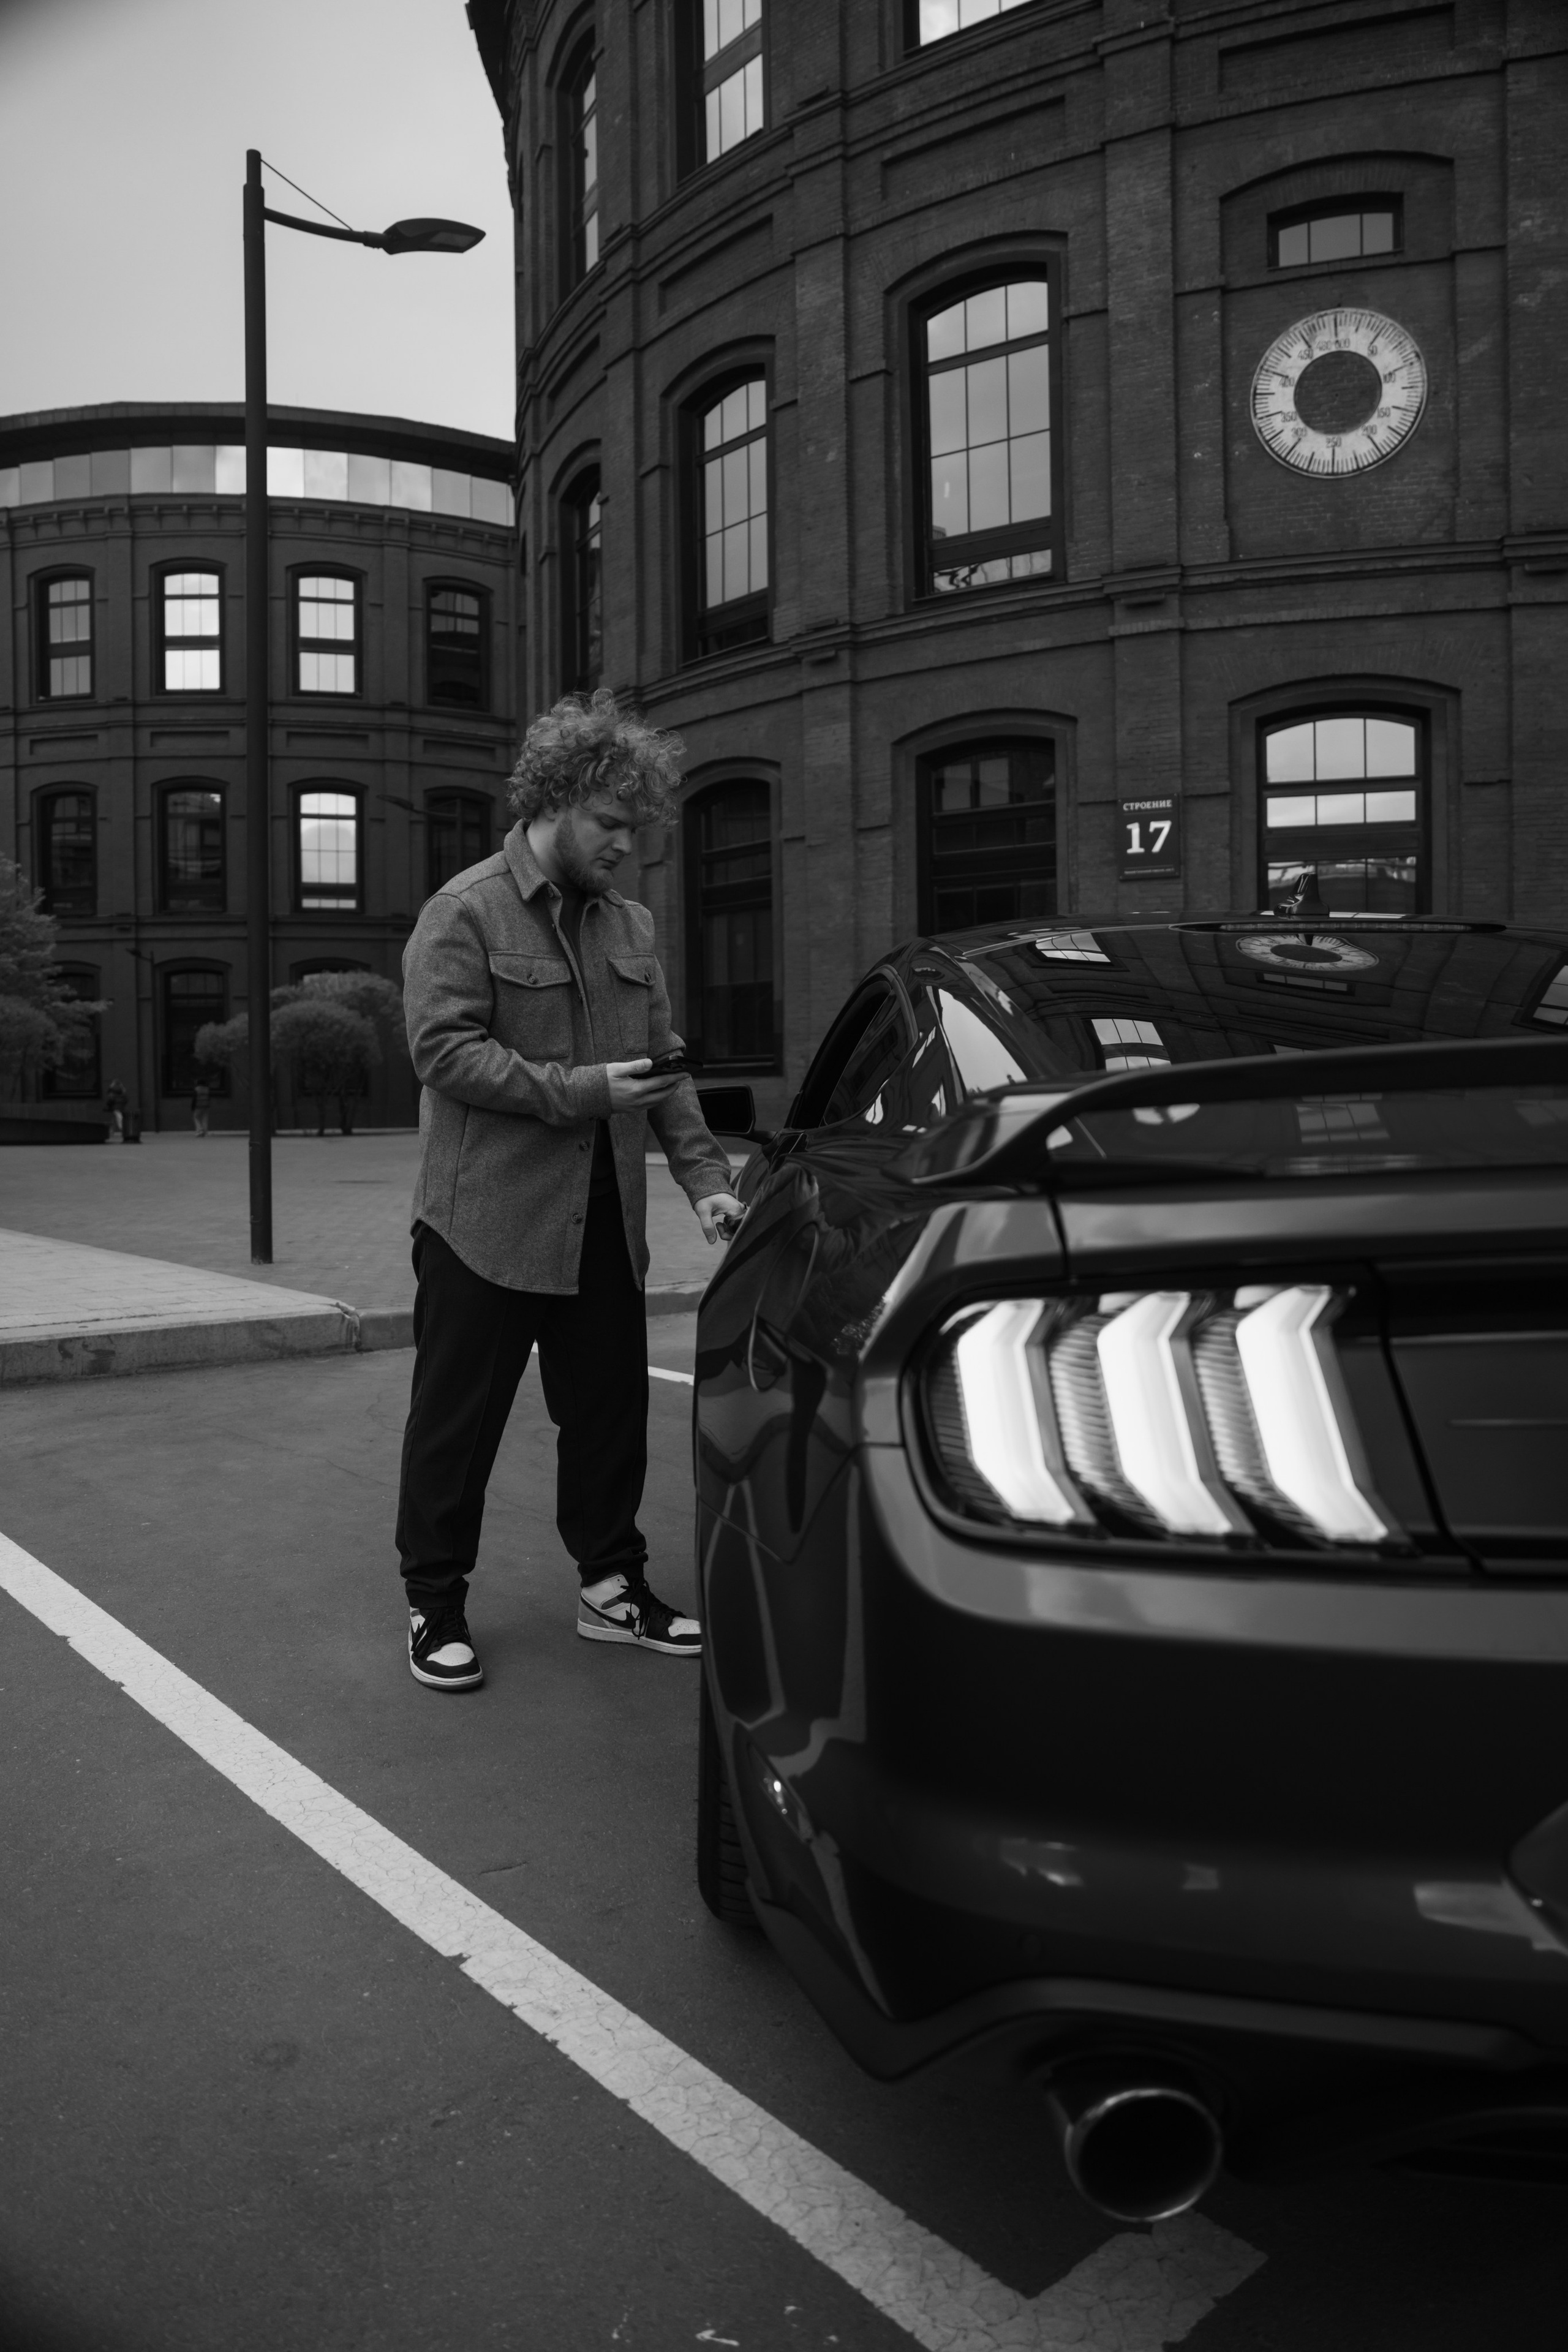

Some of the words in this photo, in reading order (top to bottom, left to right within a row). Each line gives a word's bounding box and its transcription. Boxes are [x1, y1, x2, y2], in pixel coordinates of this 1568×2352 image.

[1297, 348, 1314, 360] 450
[1367, 345, 1378, 357] 50
[1278, 376, 1295, 388] 400
[1383, 372, 1396, 383] 100
[1281, 411, 1297, 423] 350
[1377, 406, 1391, 419] 150
[1362, 424, 1377, 436] 200
[1326, 435, 1342, 448] 250
[1123, 799, 1172, 811] СТРОЕНИЕ
[1126, 820, 1172, 854] 17
